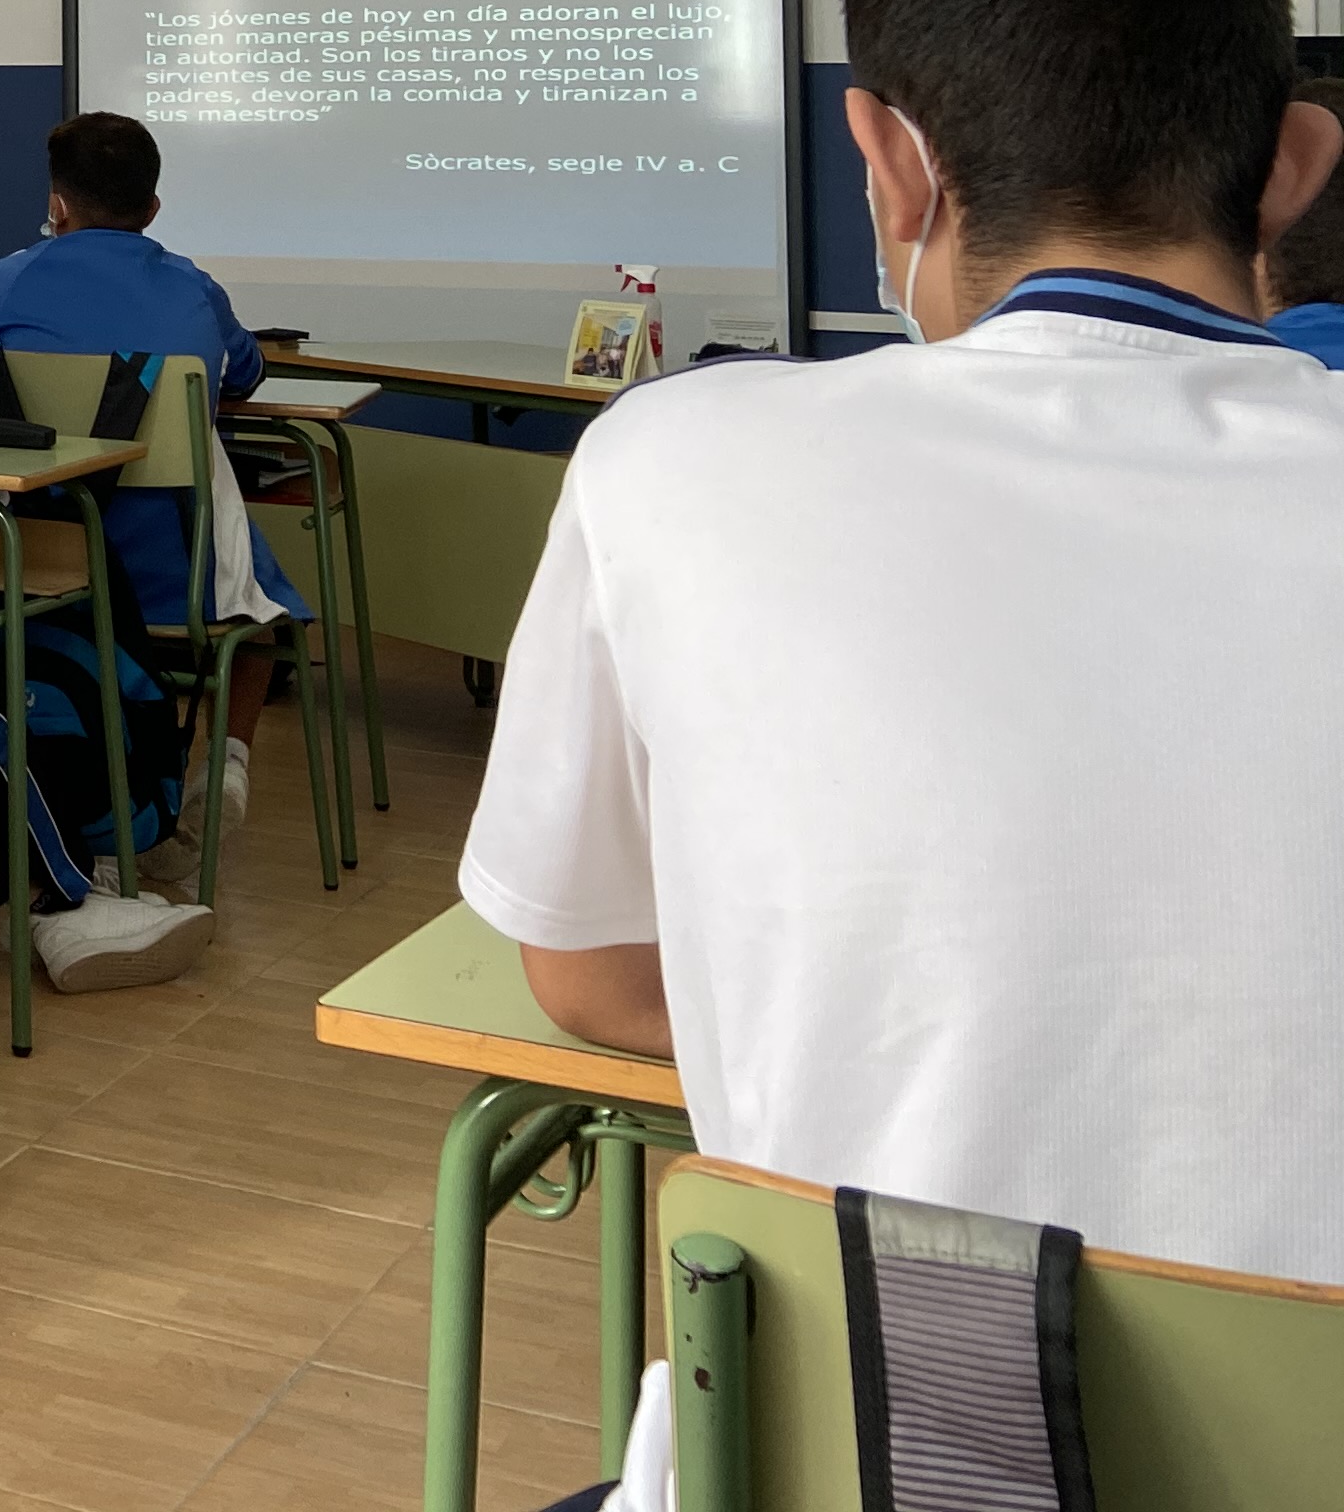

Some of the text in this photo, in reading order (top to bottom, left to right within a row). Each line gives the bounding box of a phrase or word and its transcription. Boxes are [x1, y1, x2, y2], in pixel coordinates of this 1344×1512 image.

[208, 9, 311, 29] jóvenes
[321, 9, 353, 24] de
[363, 8, 412, 26] hoy
[423, 10, 455, 21] en
[467, 5, 508, 22] día
[519, 5, 618, 21] adoran
[631, 4, 655, 19] el
[668, 3, 731, 23] lujo,
[146, 24, 713, 46] tienen maneras pésimas y menosprecian
[146, 45, 654, 65] la autoridad. Son los tiranos y no los
[145, 64, 699, 84] sirvientes de sus casas, no respetan los
[146, 86, 698, 106] padres, devoran la comida y tiranizan a
[145, 110, 187, 122] sus
[405, 153, 740, 175] Sòcrates, segle IV a. C
